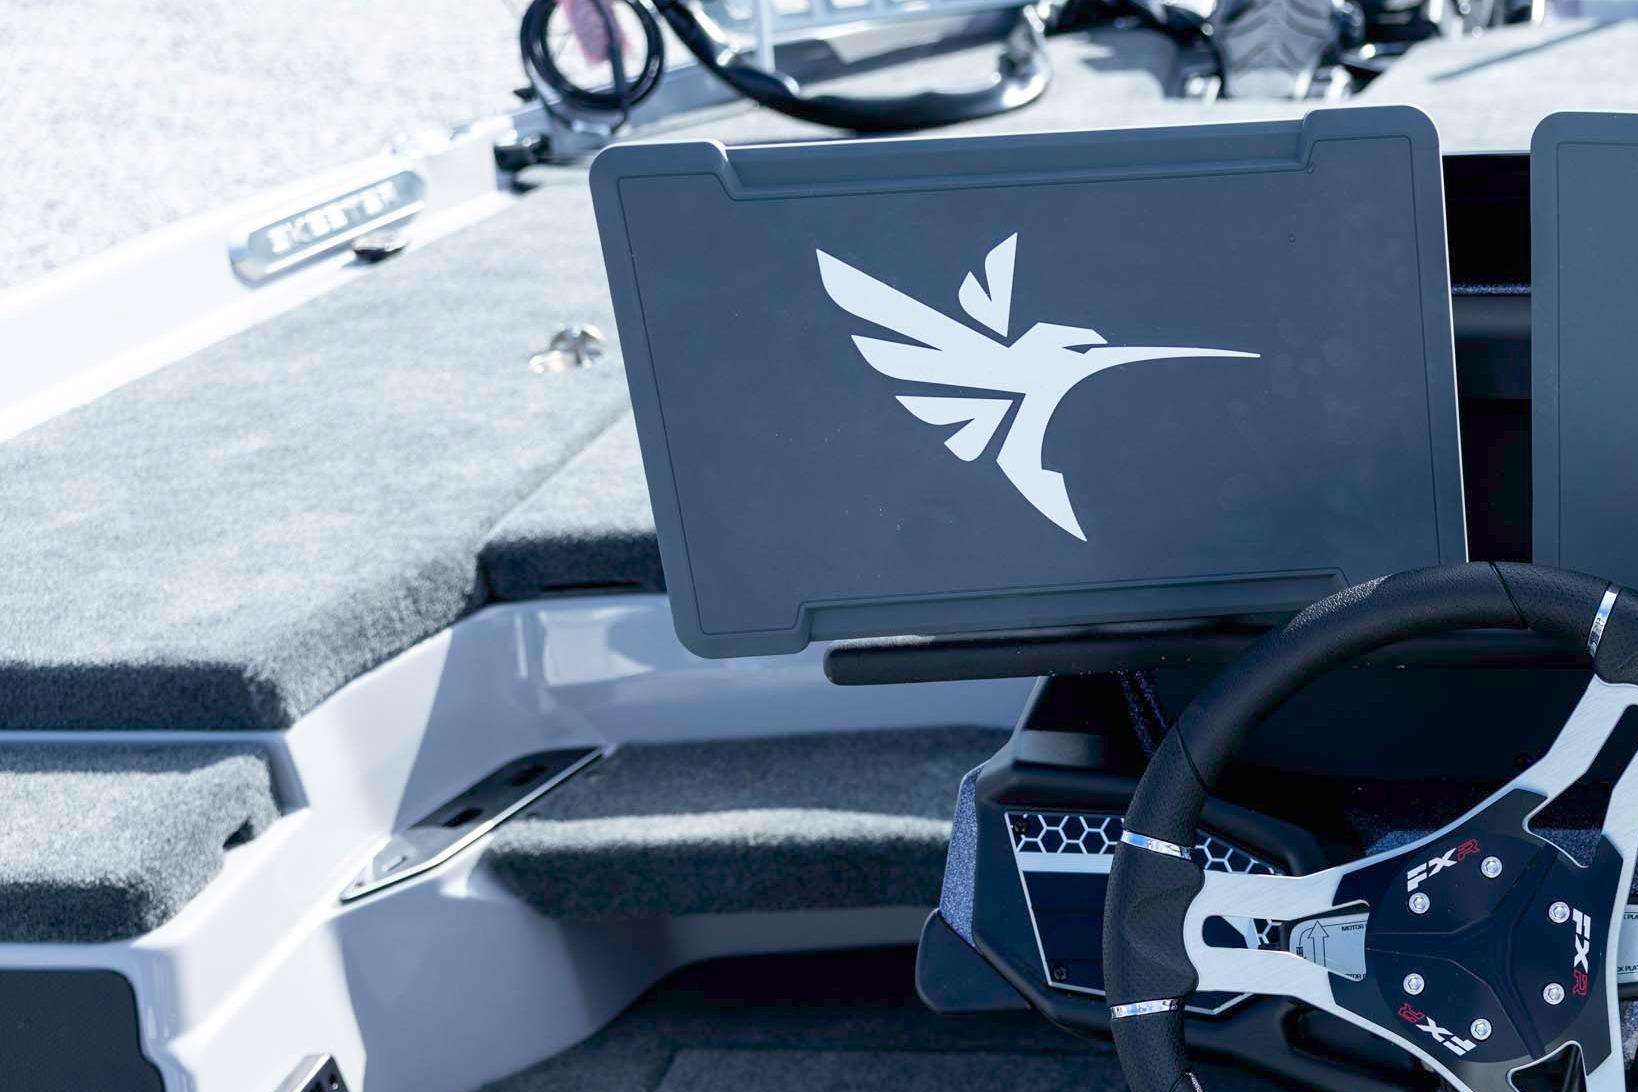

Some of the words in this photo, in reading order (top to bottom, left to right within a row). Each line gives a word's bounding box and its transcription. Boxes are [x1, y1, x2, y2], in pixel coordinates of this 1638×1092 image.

[1406, 838, 1481, 892] FXR
[1571, 907, 1592, 997] FXR
[1398, 1002, 1478, 1057] FXR
